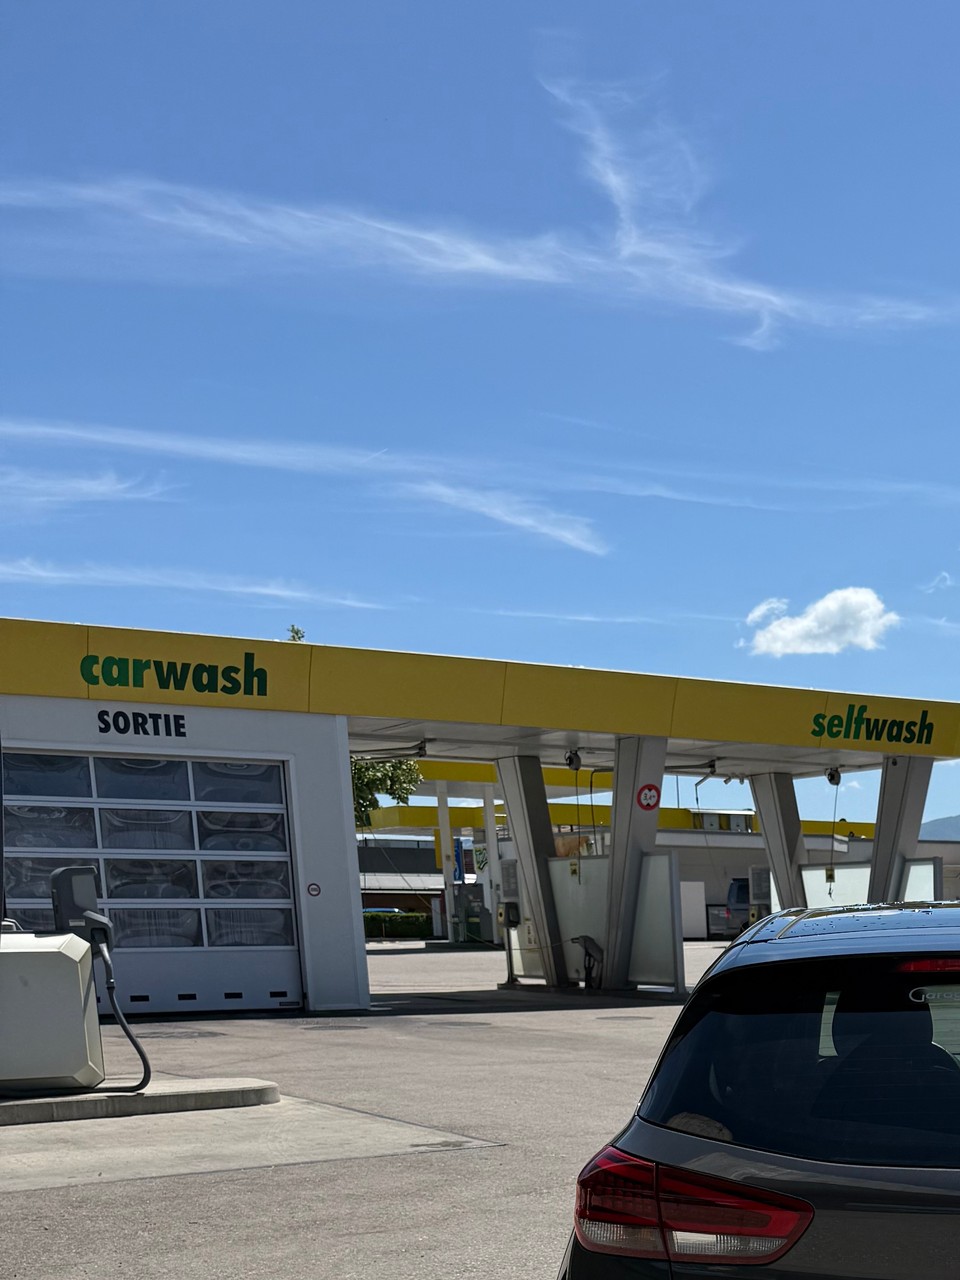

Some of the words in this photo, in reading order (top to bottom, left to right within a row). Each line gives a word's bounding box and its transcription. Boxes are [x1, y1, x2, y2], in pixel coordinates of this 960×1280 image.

[80, 652, 268, 696] carwash
[97, 710, 187, 738] SORTIE
[811, 704, 934, 744] selfwash
